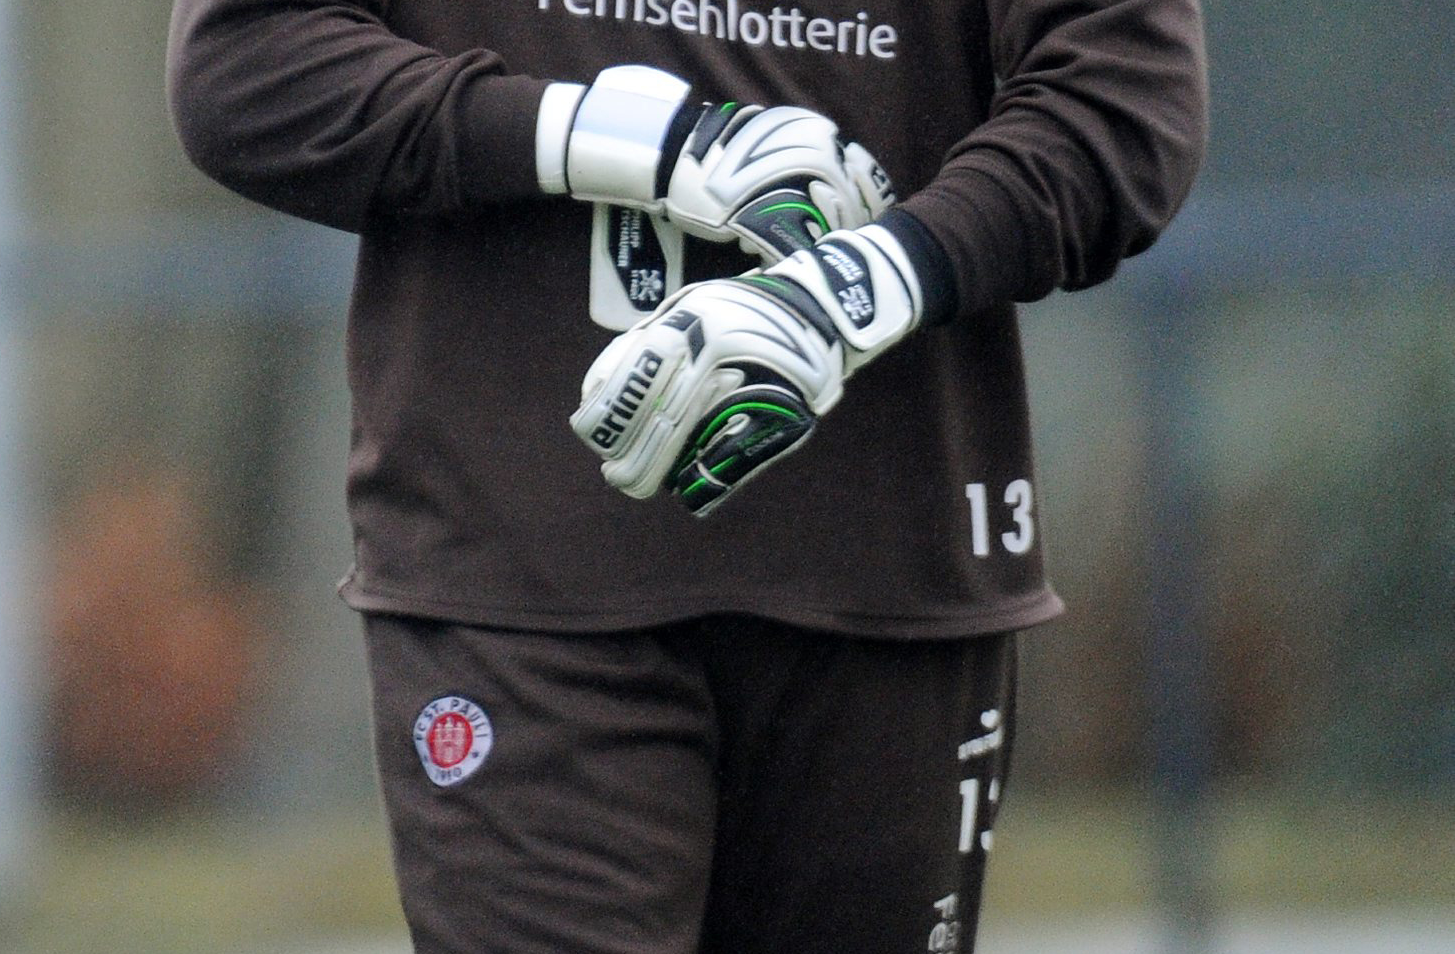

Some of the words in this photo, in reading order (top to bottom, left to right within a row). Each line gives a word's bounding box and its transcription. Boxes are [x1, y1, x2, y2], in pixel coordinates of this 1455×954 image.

[591, 349, 663, 449] erima
[964, 479, 1035, 557] 13
[958, 777, 1000, 853] 1
